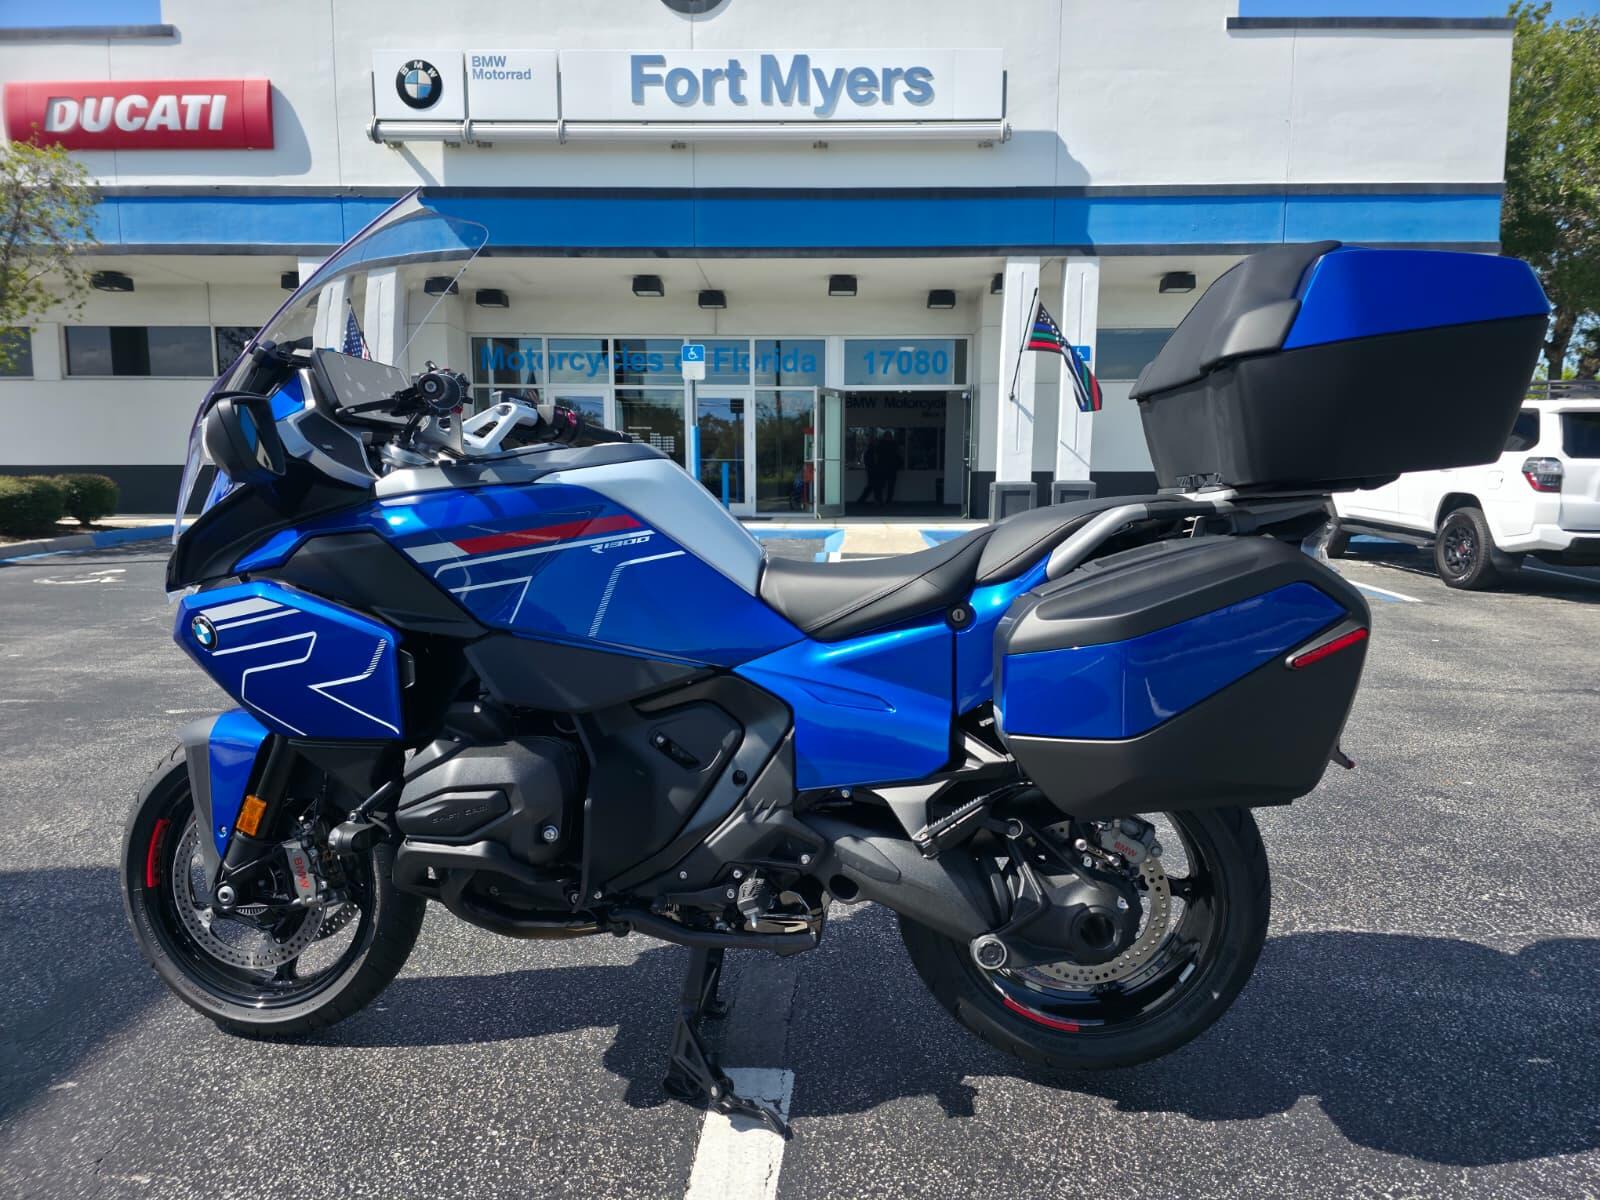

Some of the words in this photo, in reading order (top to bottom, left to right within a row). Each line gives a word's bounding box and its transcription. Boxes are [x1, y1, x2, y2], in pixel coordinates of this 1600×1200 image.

[472, 55, 507, 67] BMW
[472, 68, 532, 80] Motorrad
[630, 54, 748, 107] Fort
[760, 54, 935, 118] Myers
[45, 94, 227, 132] DUCATI
[480, 345, 664, 377] Motorcycles
[713, 346, 817, 372] Florida
[863, 350, 948, 375] 17080
[884, 396, 946, 411] Motorcycl
[1113, 841, 1138, 857] BMW
